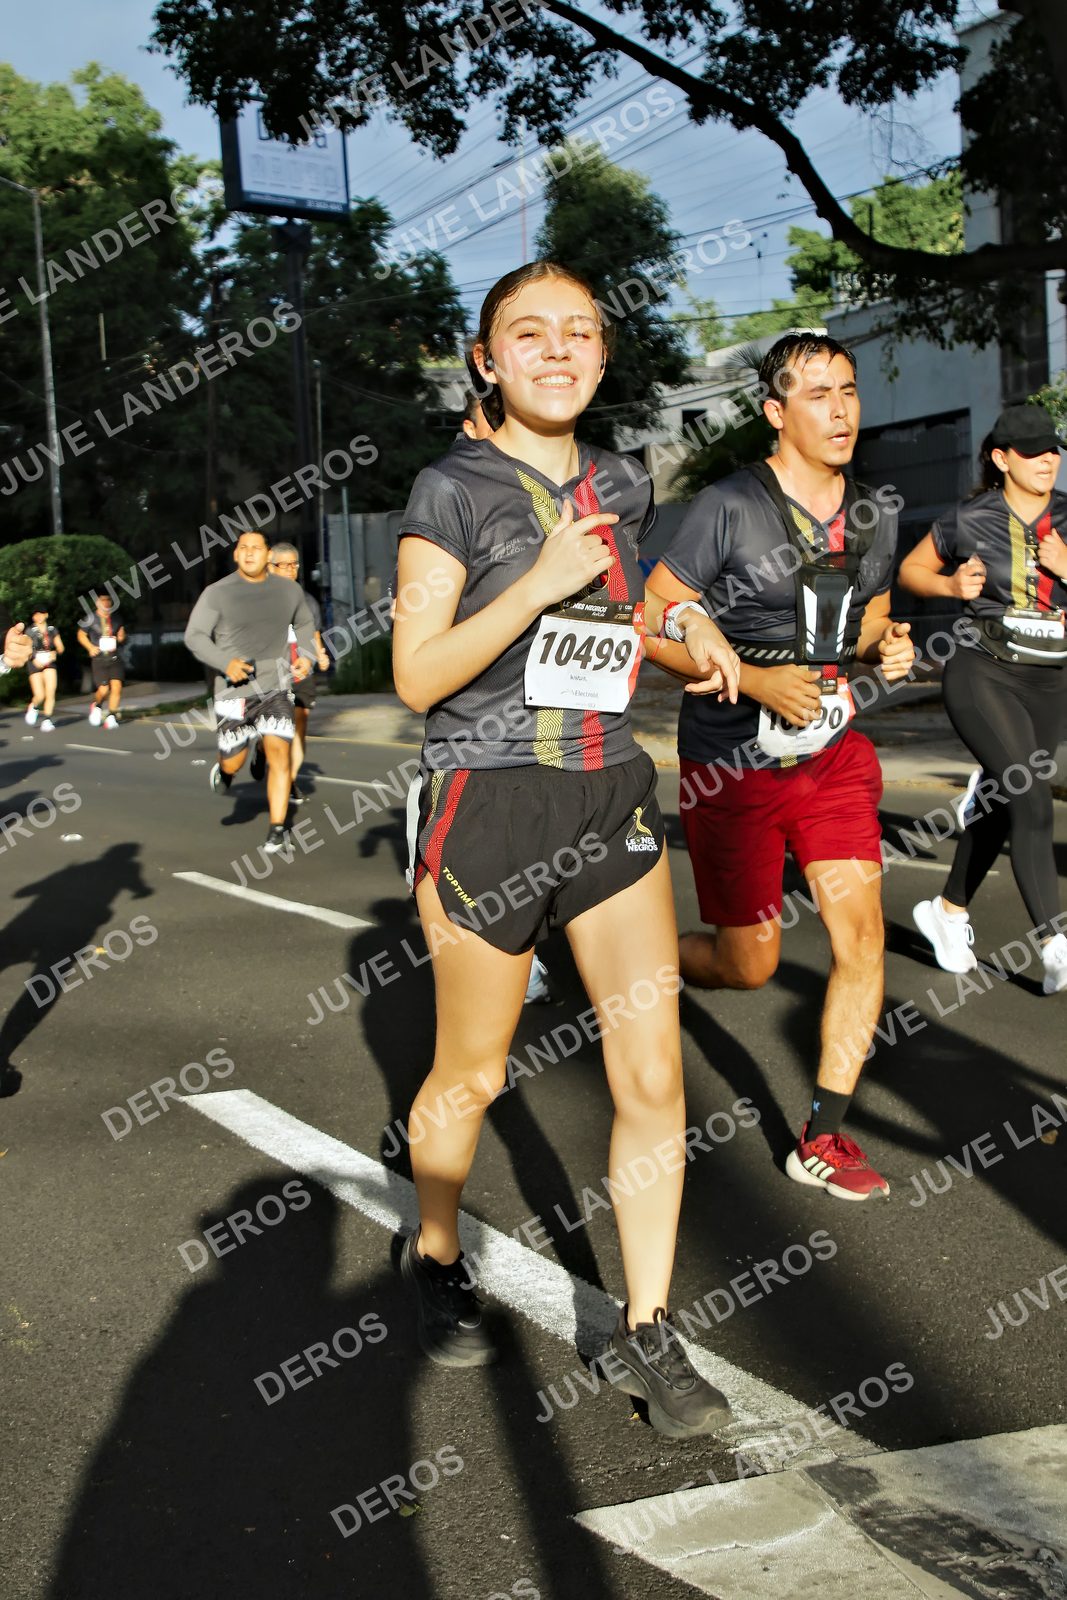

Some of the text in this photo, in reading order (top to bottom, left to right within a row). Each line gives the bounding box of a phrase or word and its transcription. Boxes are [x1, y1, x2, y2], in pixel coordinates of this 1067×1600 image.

[539, 631, 633, 672] 10499
[627, 844, 659, 852] NEGROS
[442, 866, 477, 909] TOPTIME
